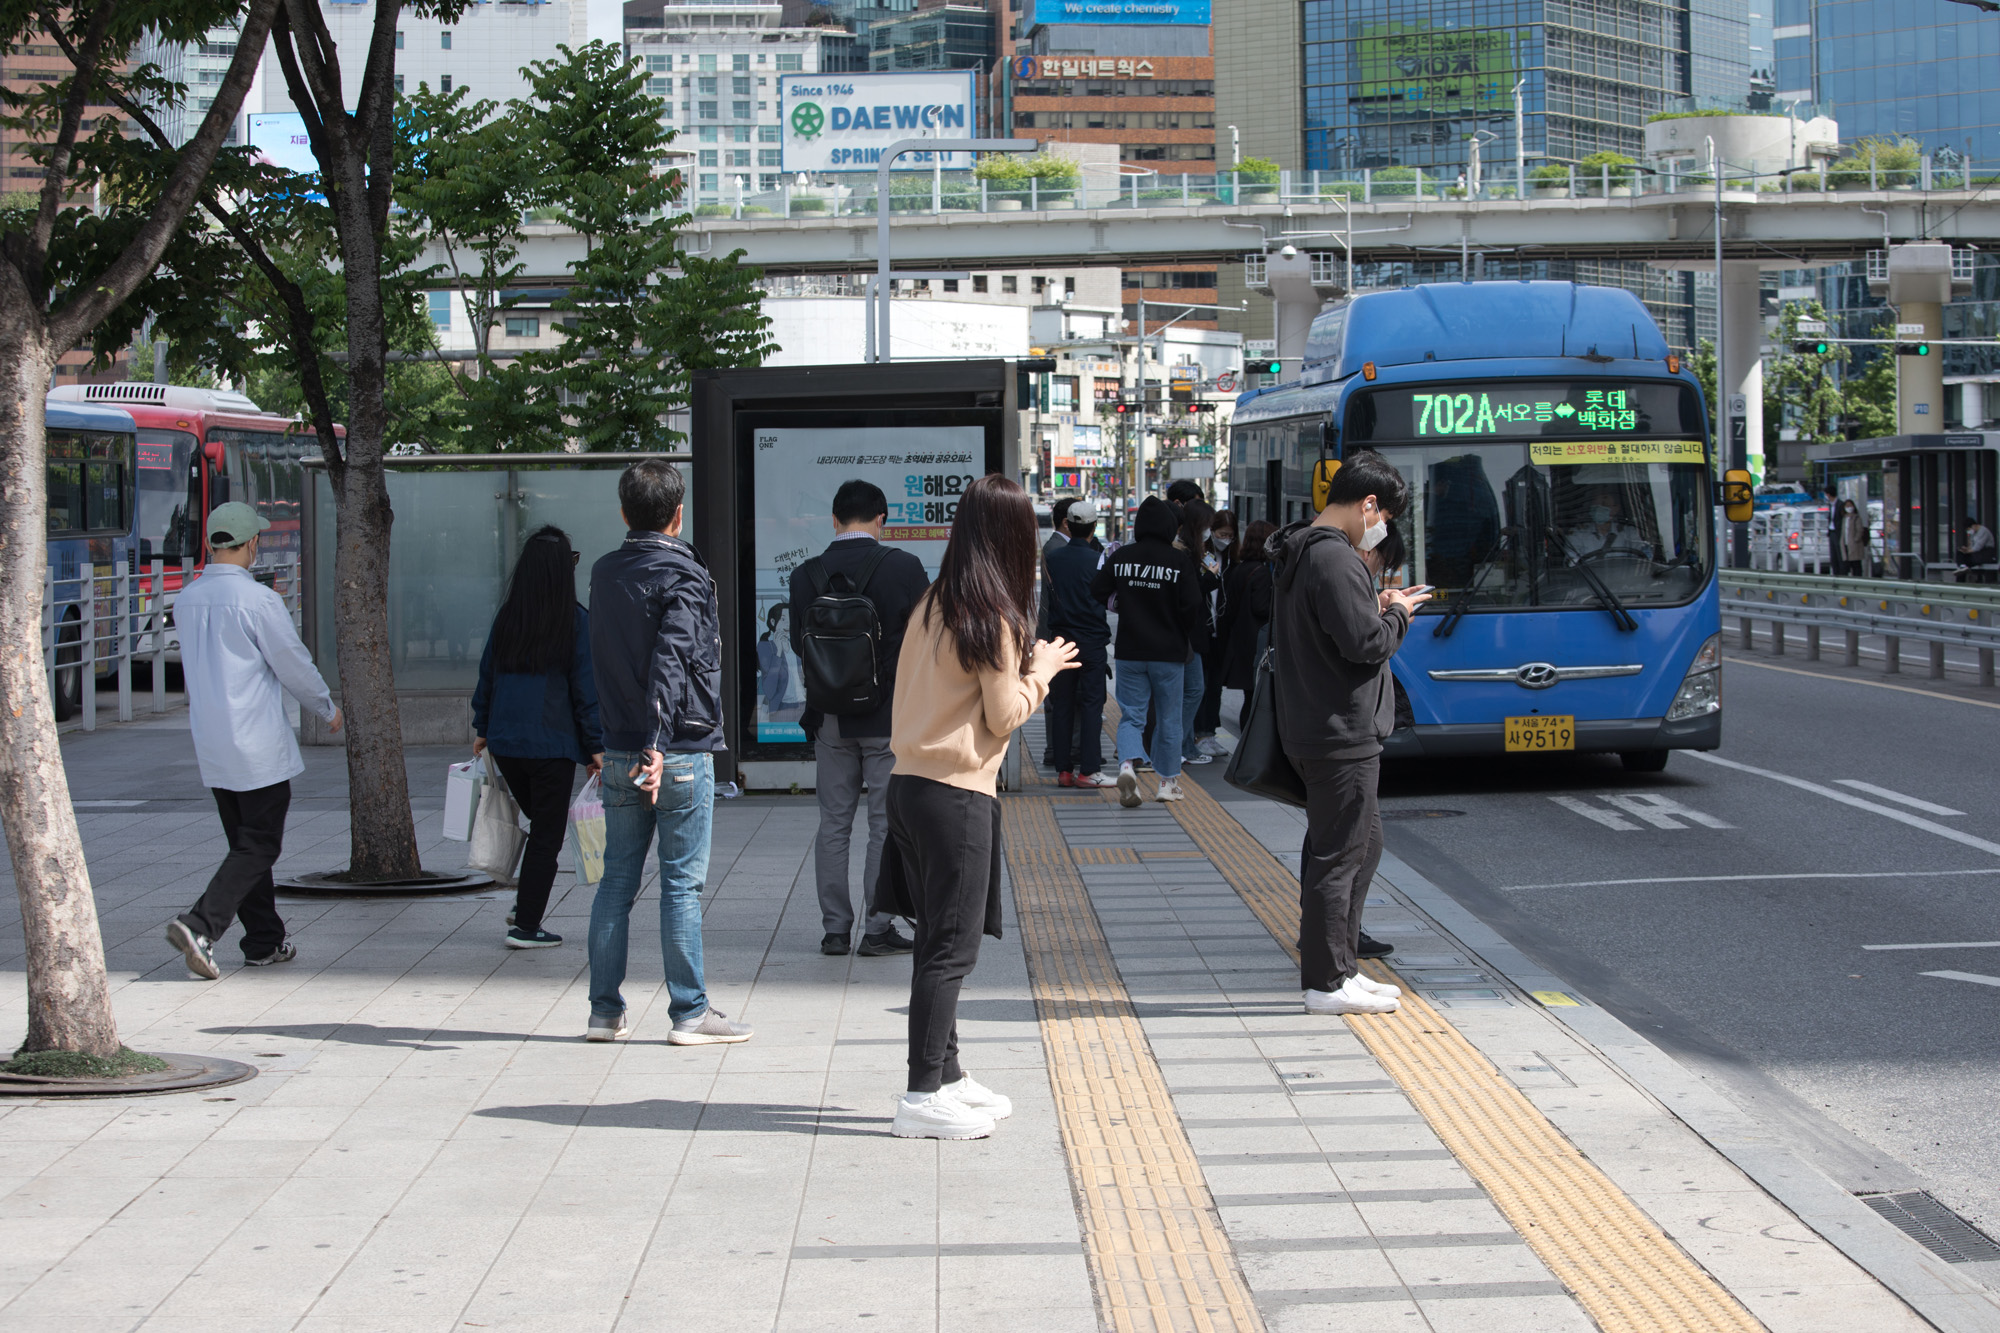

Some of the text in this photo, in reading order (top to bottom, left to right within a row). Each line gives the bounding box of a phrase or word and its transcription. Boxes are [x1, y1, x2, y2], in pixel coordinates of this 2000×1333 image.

[1065, 2, 1180, 15] We create chemistry
[1042, 59, 1154, 77] 한일네트웍스
[791, 83, 854, 96] Since 1946
[831, 103, 964, 131] DAEWON
[1585, 390, 1627, 410] 롯데
[1413, 393, 1554, 435] 702A 서오릉
[1578, 410, 1636, 431] 백화점
[1735, 421, 1745, 436] 7
[1532, 445, 1562, 456] 저희는
[1566, 443, 1617, 456] 신호위반을
[1620, 443, 1660, 454] 절대하지
[817, 453, 973, 465] 내리자마자 출근도장 찍는 초역세권 공유오피스
[893, 529, 909, 538] 신규
[911, 528, 927, 538] 오픈
[928, 528, 945, 538] 혜택
[774, 547, 809, 563] 대박사건!
[1522, 717, 1557, 728] 서울 74
[1508, 729, 1571, 748] 사 9519
